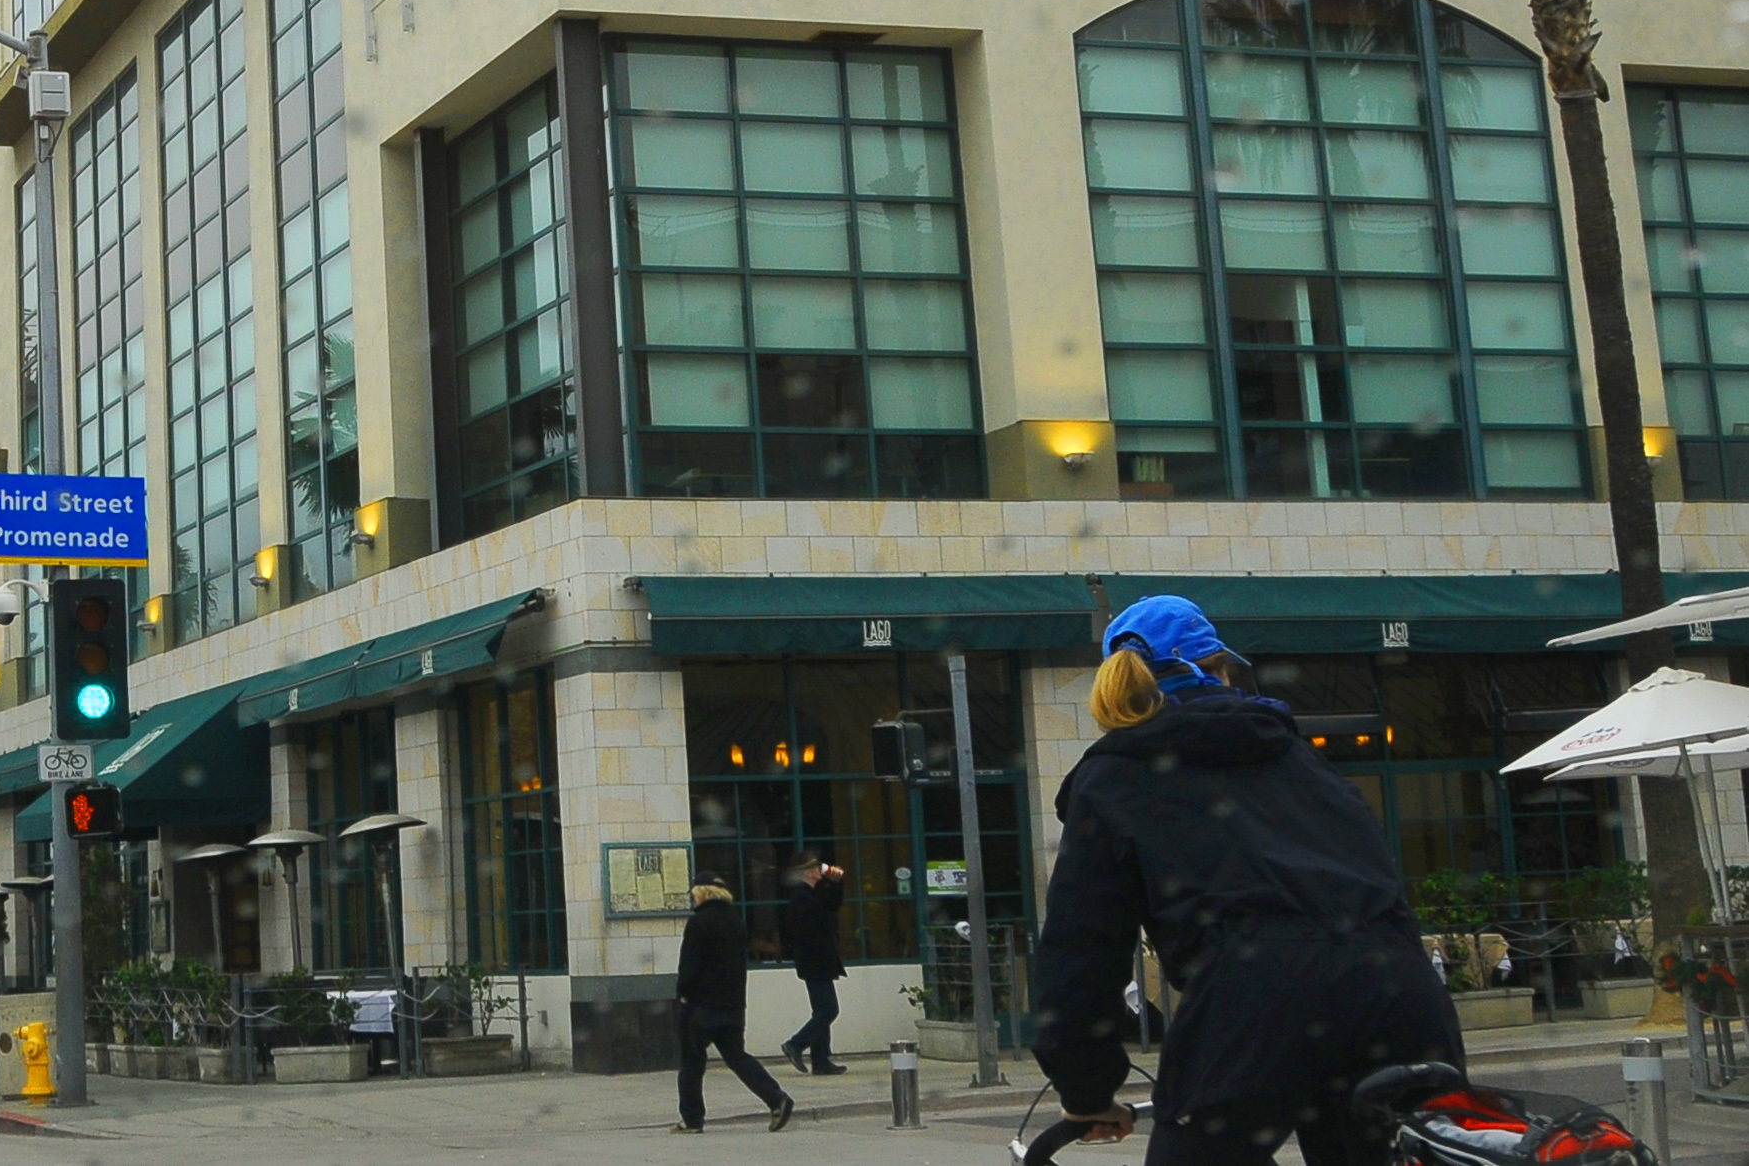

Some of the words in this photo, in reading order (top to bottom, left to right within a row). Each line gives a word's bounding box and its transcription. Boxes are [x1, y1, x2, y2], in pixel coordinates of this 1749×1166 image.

[59, 492, 134, 514] Street
[863, 620, 891, 640] LAGO
[1382, 622, 1408, 642] LAGO
